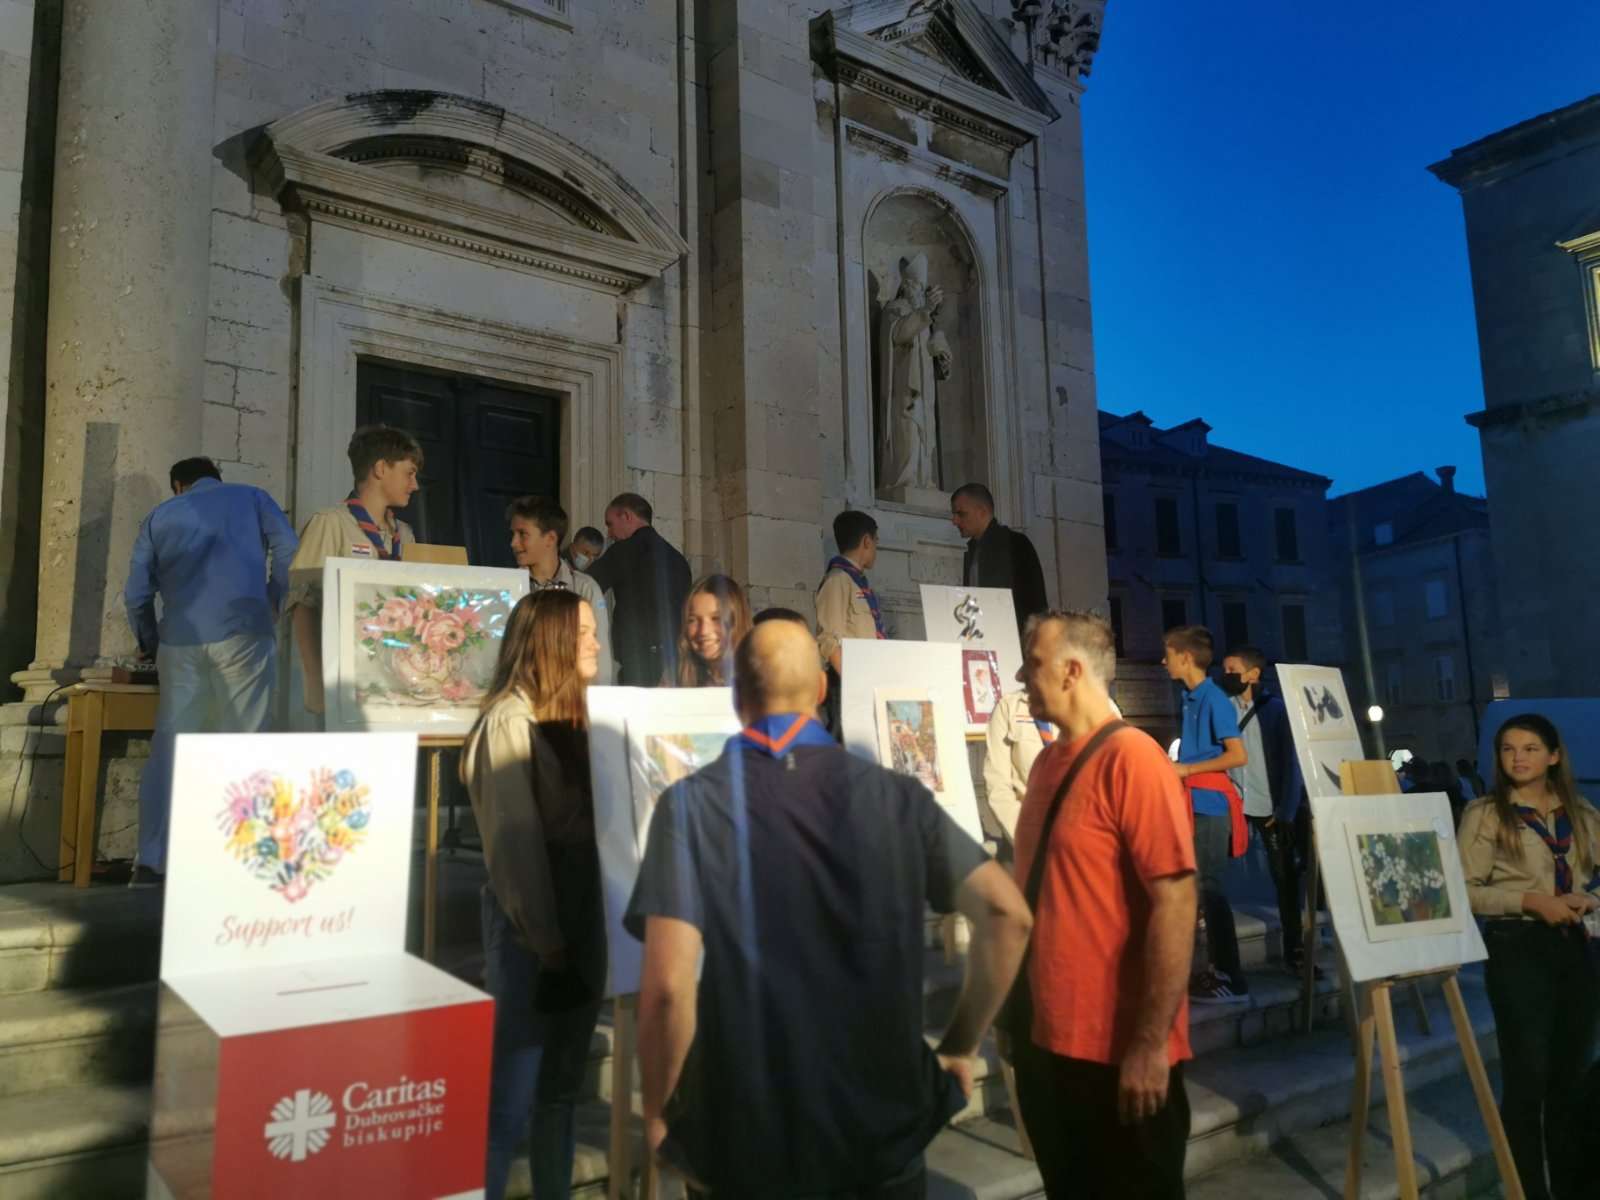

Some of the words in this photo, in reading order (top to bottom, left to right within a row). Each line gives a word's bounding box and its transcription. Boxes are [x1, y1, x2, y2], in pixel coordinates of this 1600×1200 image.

[215, 913, 312, 947] Support
[320, 907, 355, 931] us!
[342, 1075, 447, 1113] Caritas
[345, 1102, 444, 1130] Dubrovačke
[343, 1119, 443, 1147] biskupije
